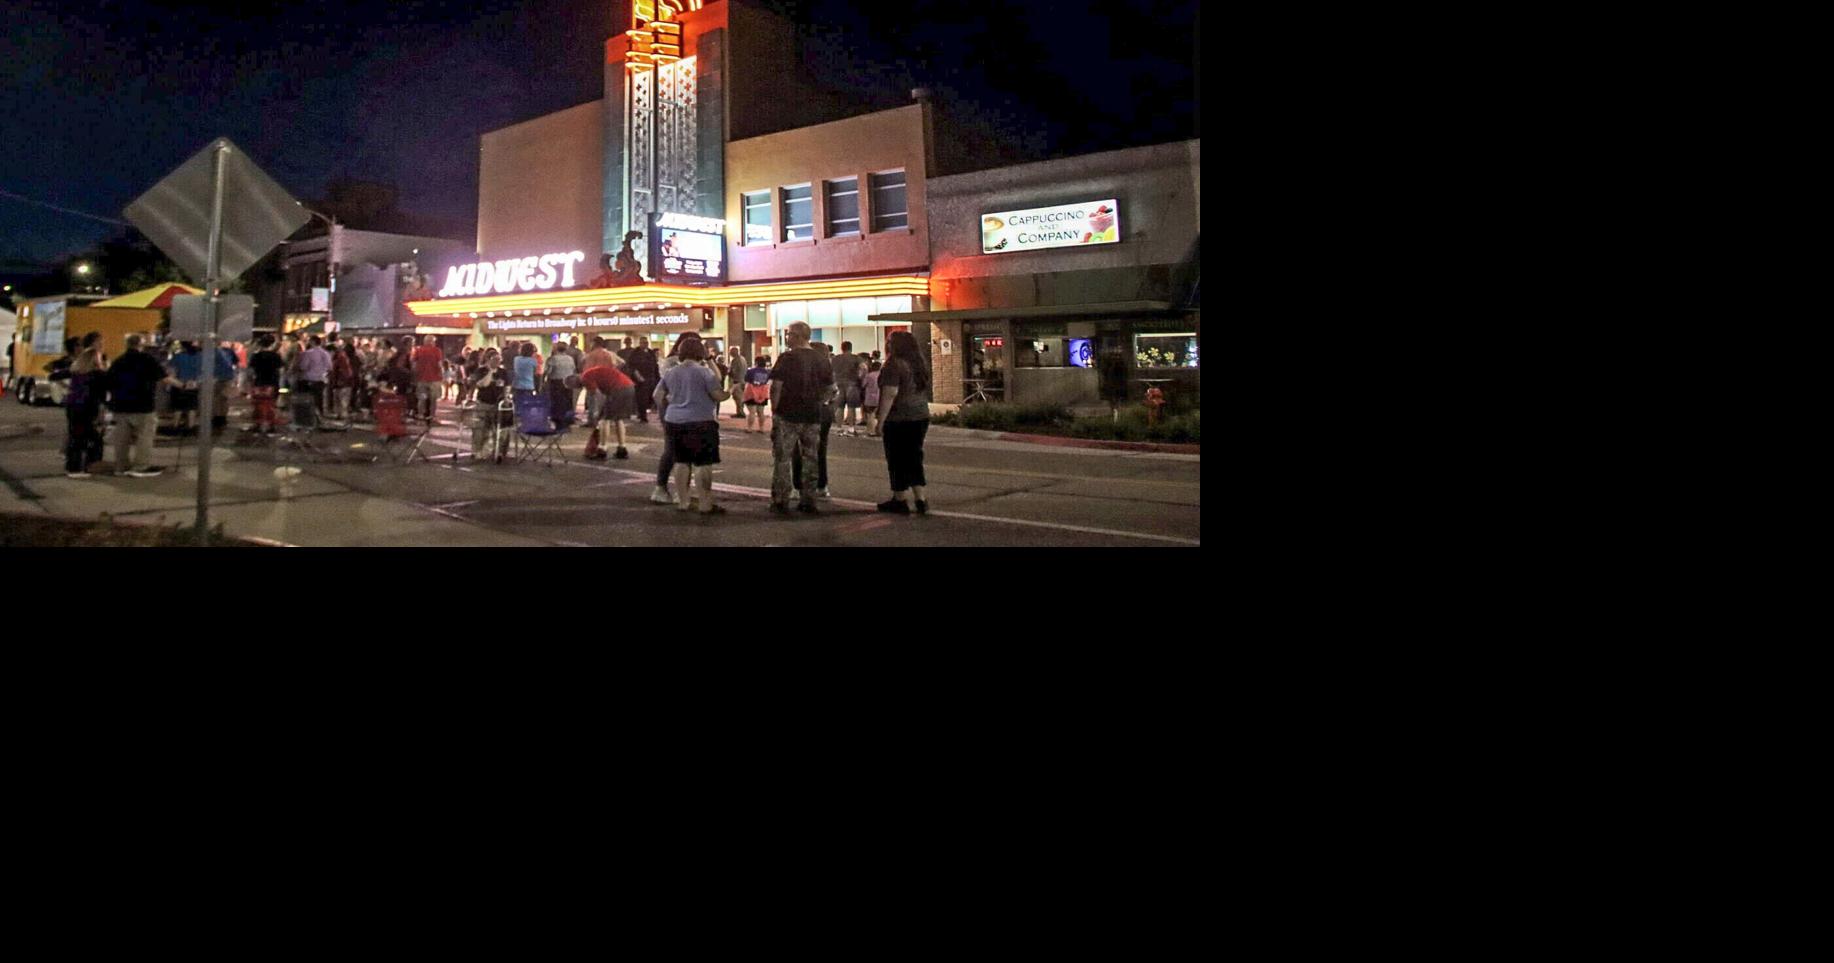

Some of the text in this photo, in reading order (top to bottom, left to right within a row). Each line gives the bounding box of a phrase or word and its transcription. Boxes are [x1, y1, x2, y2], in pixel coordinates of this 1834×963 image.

[1009, 211, 1084, 226] CAPPUCCINO
[1018, 231, 1080, 244] COMPANY
[439, 250, 585, 297] MIDWEST
[656, 313, 688, 324] seconds
